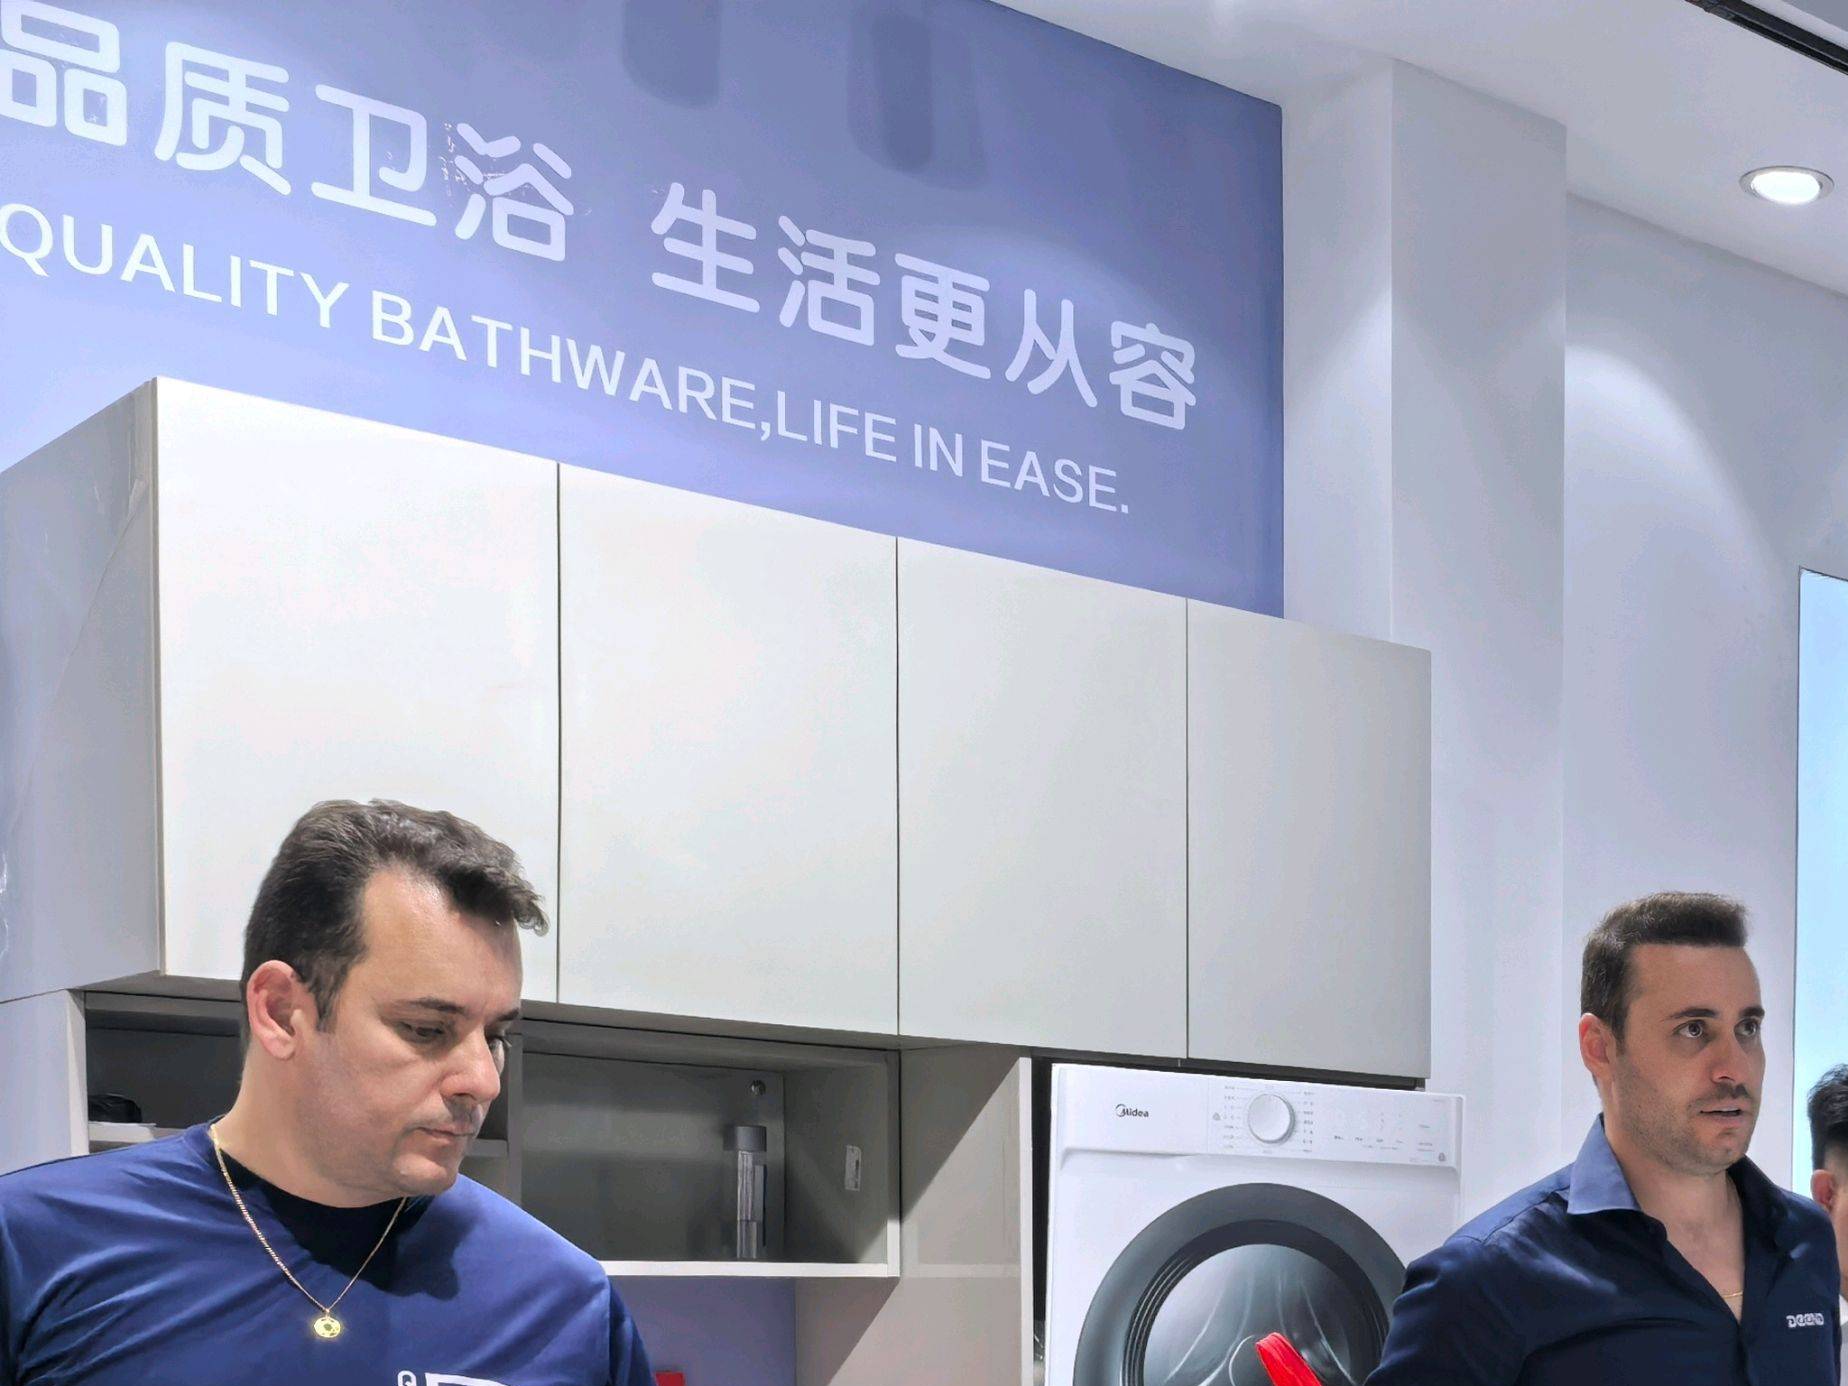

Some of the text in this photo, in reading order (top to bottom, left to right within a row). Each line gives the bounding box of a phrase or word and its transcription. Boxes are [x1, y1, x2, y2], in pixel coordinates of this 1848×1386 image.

[0, 0, 1196, 430] 品质卫浴 生活更从容
[0, 203, 349, 328] QUALITY
[914, 422, 964, 477] IN
[980, 440, 1129, 513] EASE.
[1115, 1103, 1149, 1118] Midea
